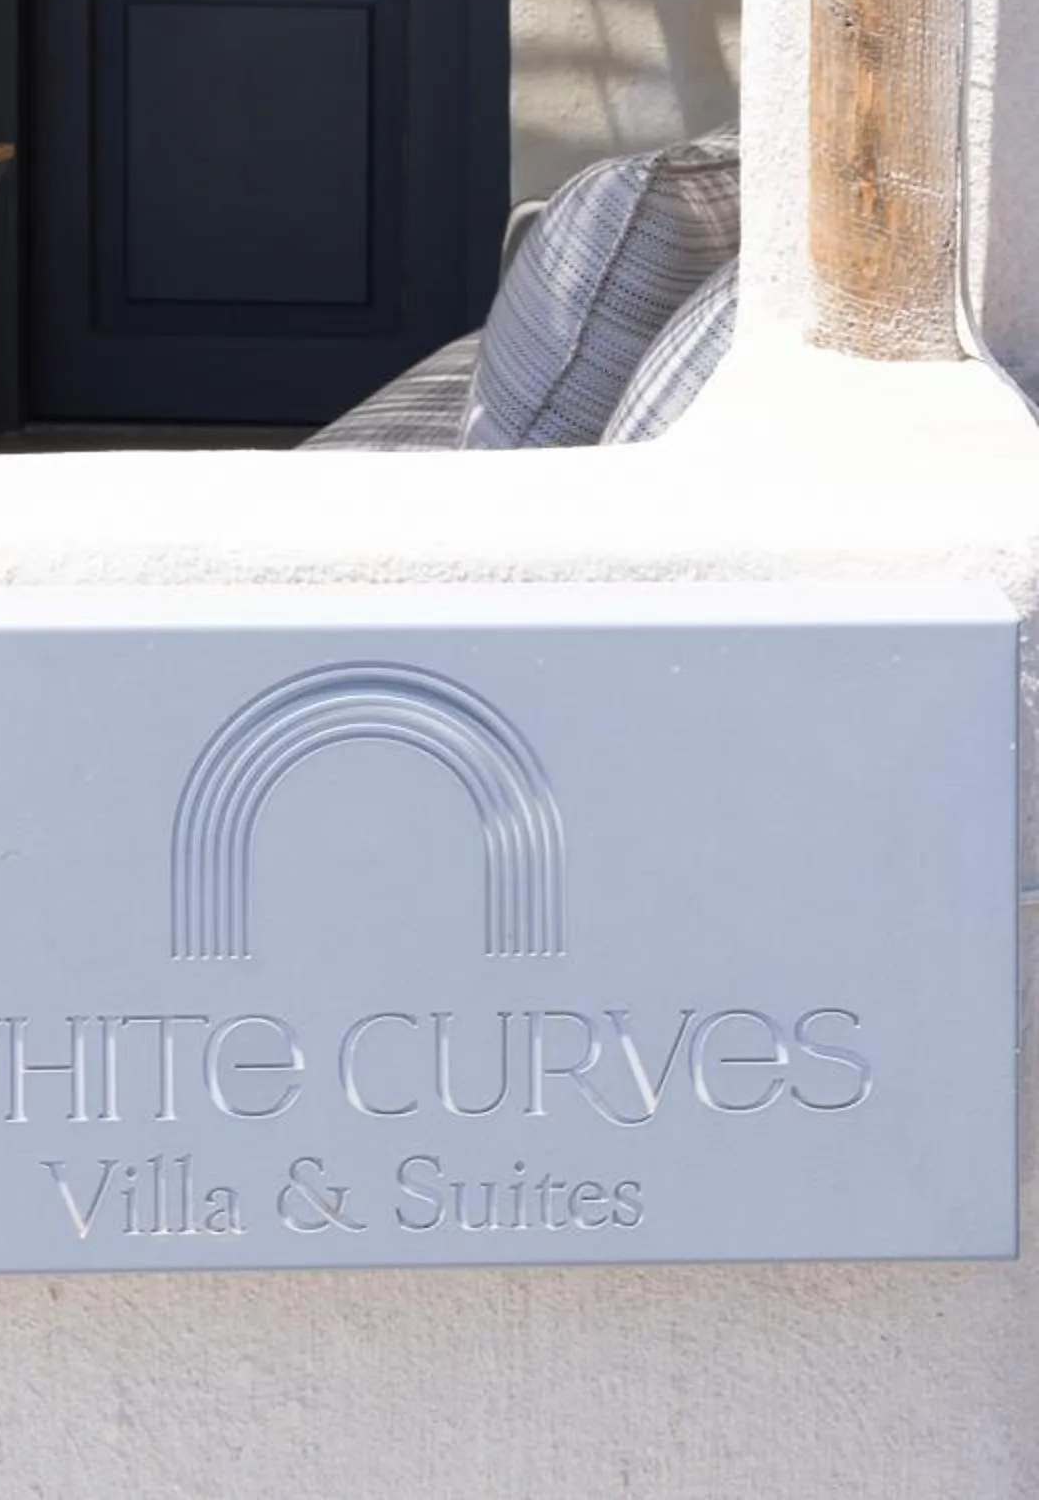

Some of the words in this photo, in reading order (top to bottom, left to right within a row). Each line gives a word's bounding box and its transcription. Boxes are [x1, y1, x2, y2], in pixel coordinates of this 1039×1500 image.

[39, 1153, 247, 1239] Villa
[276, 1156, 368, 1234] &
[395, 1154, 646, 1234] Suites
